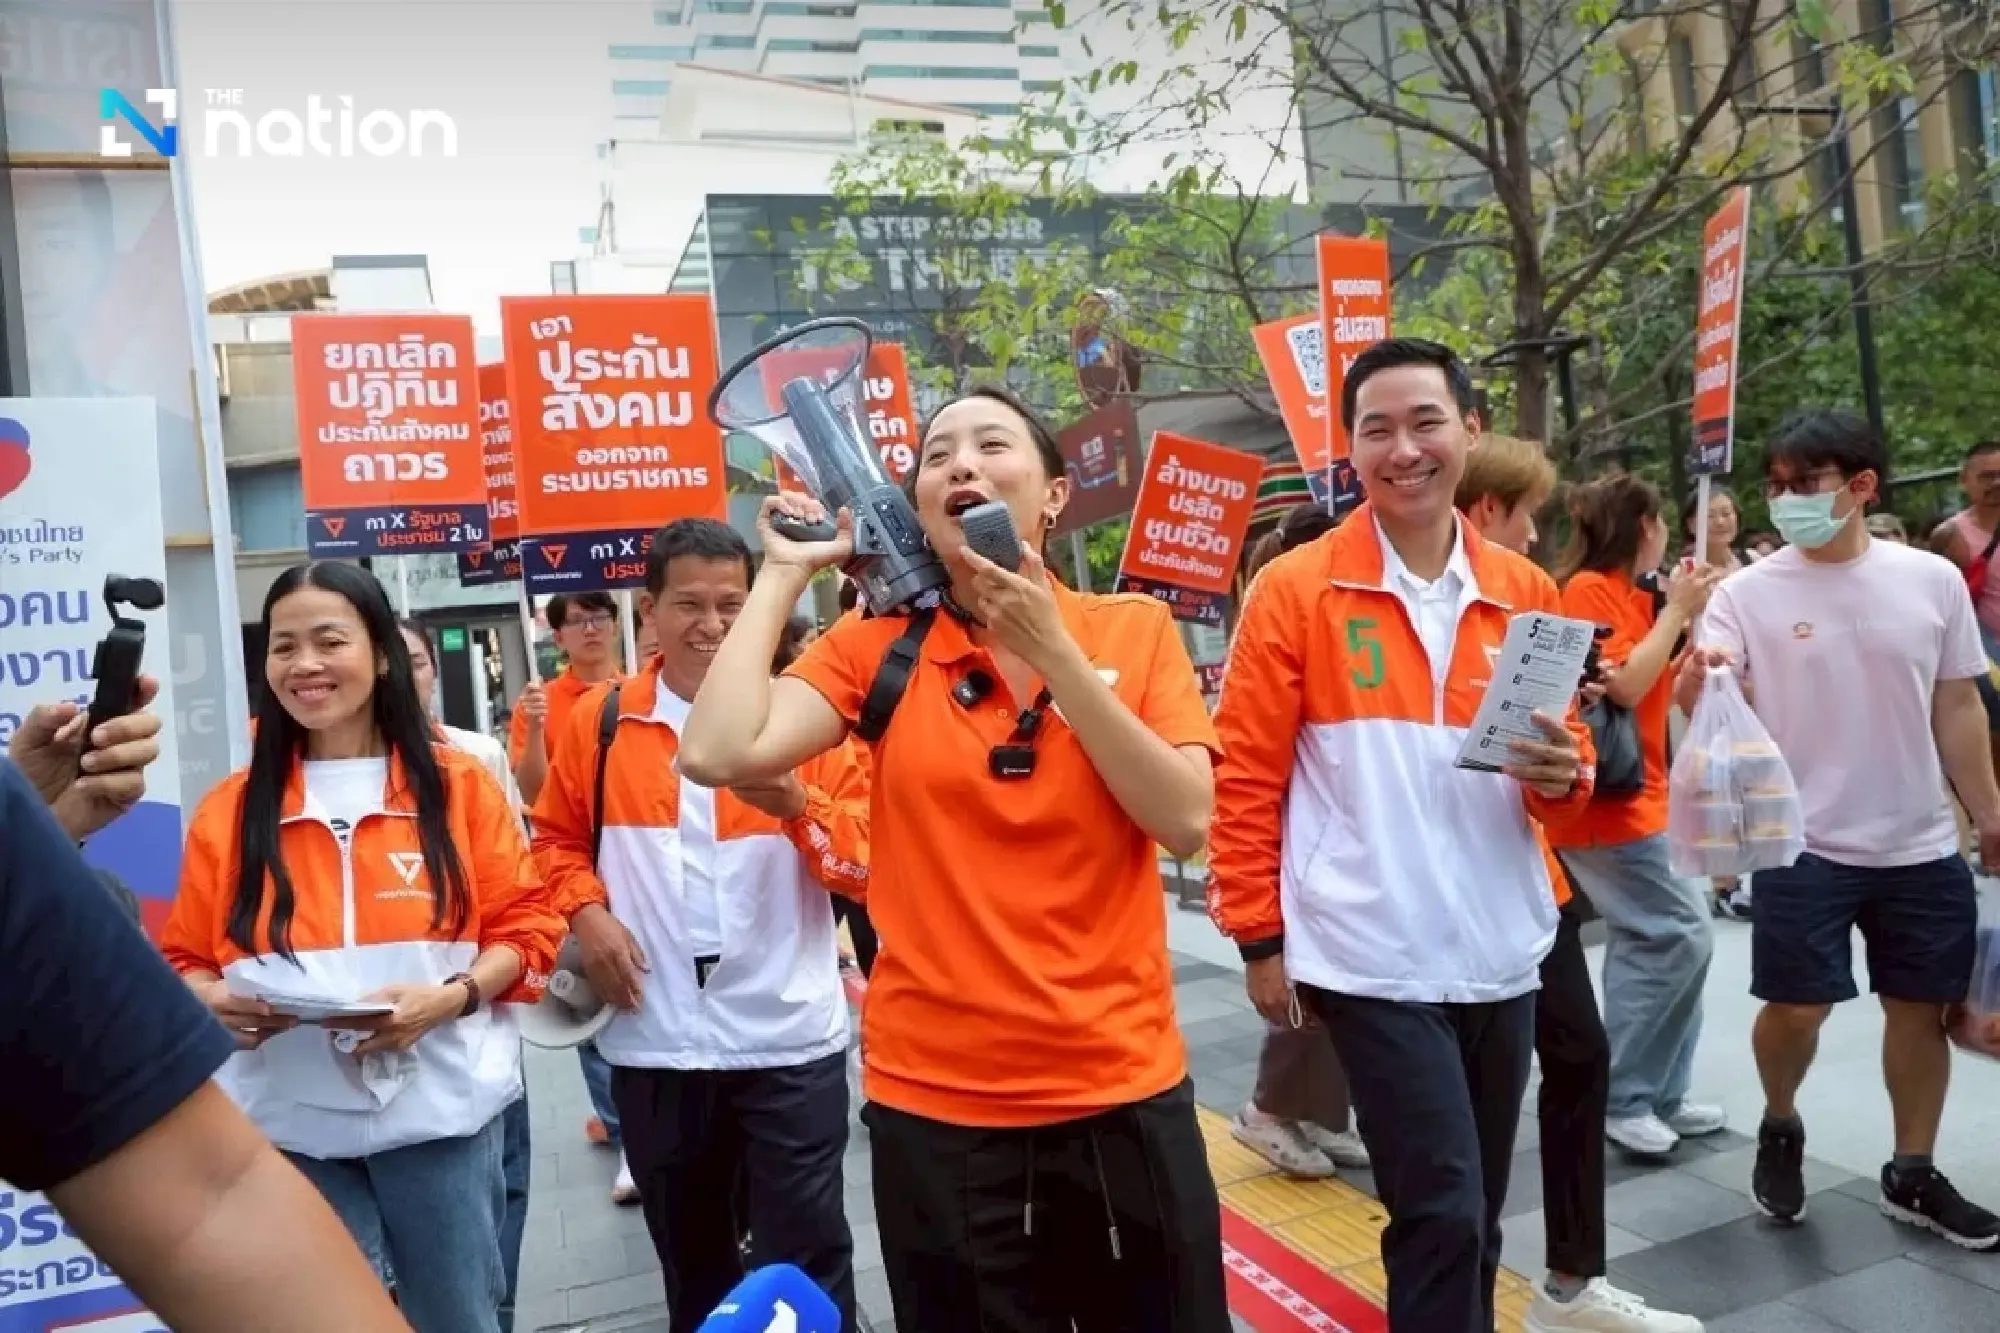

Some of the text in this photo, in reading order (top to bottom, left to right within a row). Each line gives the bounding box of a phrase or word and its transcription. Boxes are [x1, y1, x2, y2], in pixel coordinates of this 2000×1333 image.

[860, 216, 930, 240] STEP
[529, 314, 573, 340] เอา
[323, 333, 457, 369] ยกเลิก
[538, 333, 690, 381] ประกัน
[328, 370, 458, 420] ปฏิทิน
[542, 376, 694, 431] สังคม
[318, 418, 470, 443] ประกันสังคม
[343, 451, 450, 482] ถาวร
[576, 446, 669, 466] ออกจาก
[542, 467, 709, 493] ระบบราชการ
[365, 516, 386, 531] กา
[390, 512, 406, 529] X
[449, 526, 461, 542] 2
[29, 547, 84, 564] Party
[590, 543, 614, 560] กา
[619, 537, 636, 556] X
[1345, 616, 1384, 691] 5
